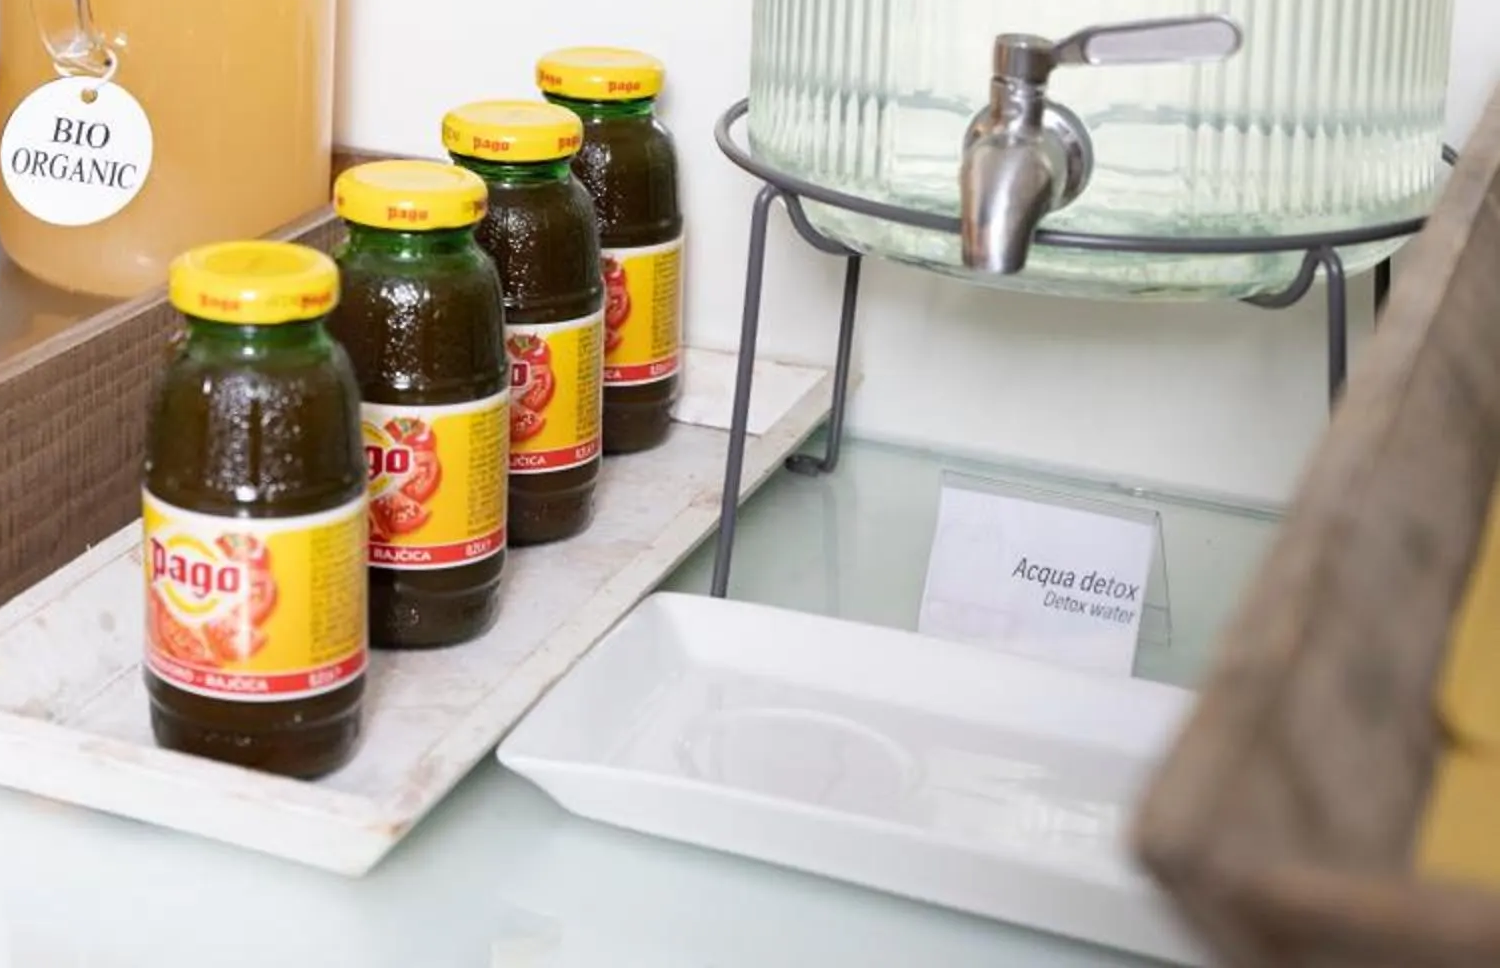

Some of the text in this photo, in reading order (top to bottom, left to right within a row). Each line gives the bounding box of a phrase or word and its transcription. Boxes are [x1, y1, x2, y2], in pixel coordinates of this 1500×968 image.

[52, 116, 111, 150] BIO
[473, 135, 510, 152] pago
[11, 147, 137, 190] ORGANIC
[365, 446, 410, 480] go
[150, 536, 241, 600] pago
[1011, 556, 1140, 602] Acqua detox
[1043, 590, 1136, 625] Detox water
